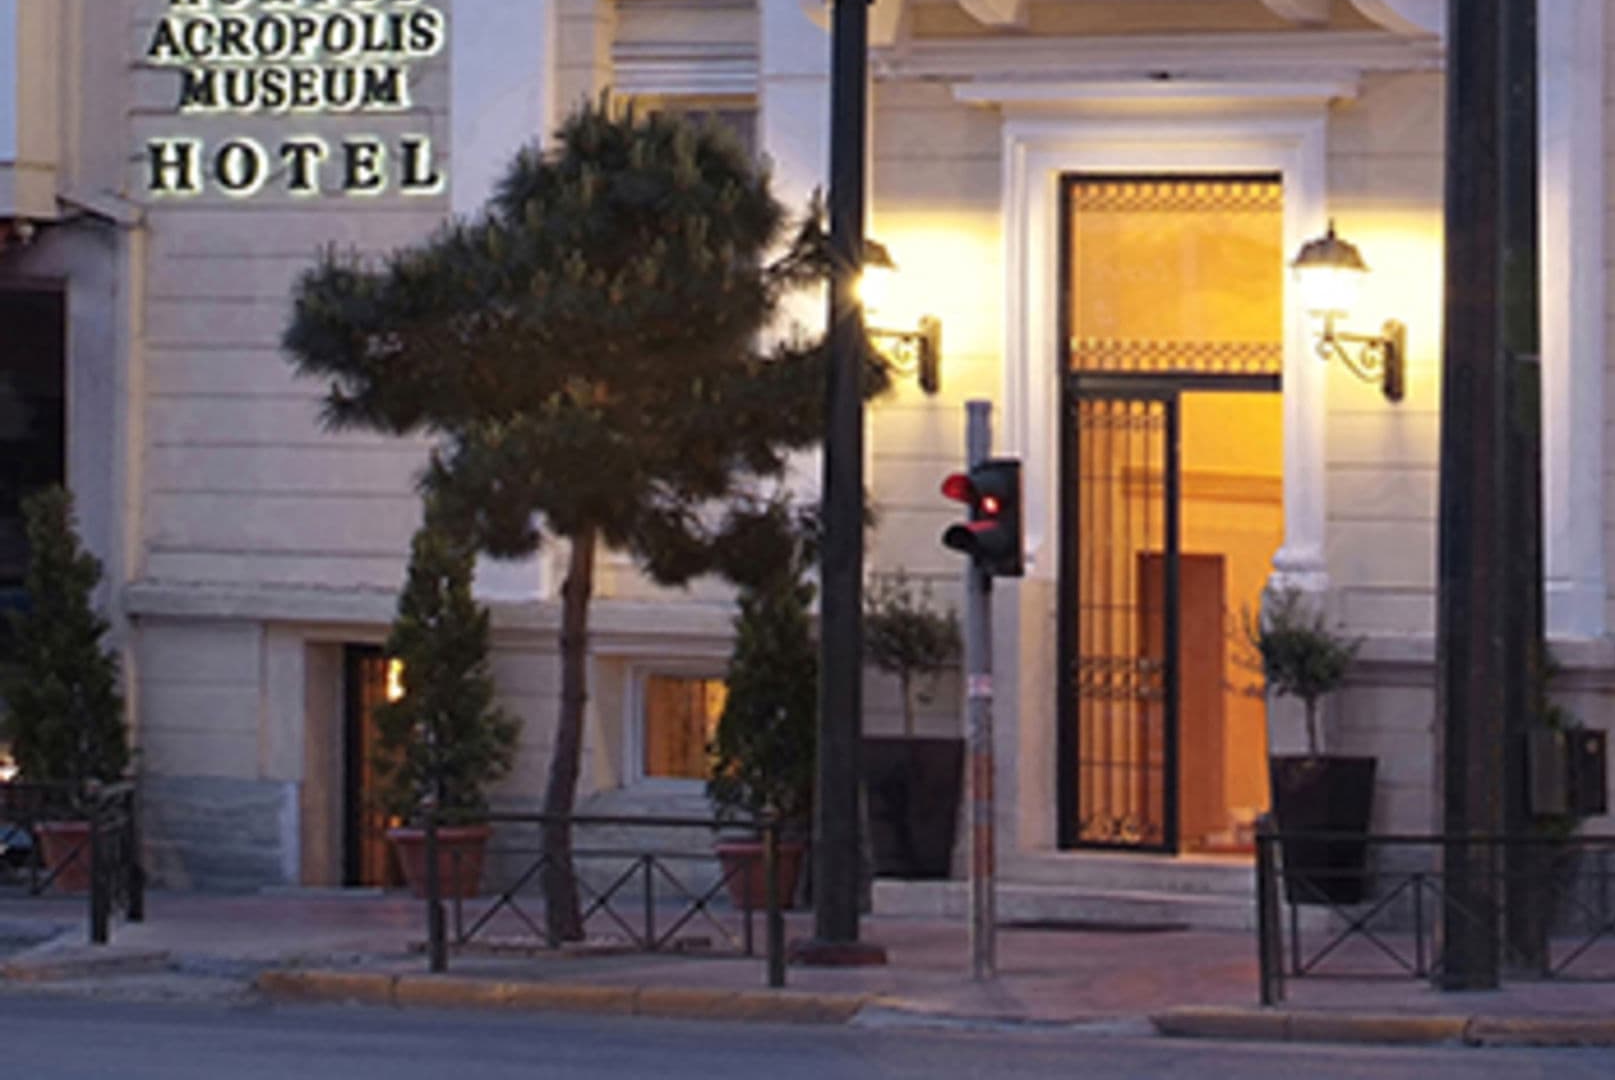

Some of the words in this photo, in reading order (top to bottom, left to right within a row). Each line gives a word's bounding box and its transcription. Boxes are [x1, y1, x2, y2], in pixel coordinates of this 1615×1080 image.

[148, 12, 438, 56] ACROPOLIS
[180, 68, 401, 107] MUSEUM
[148, 140, 441, 191] HOTEL
